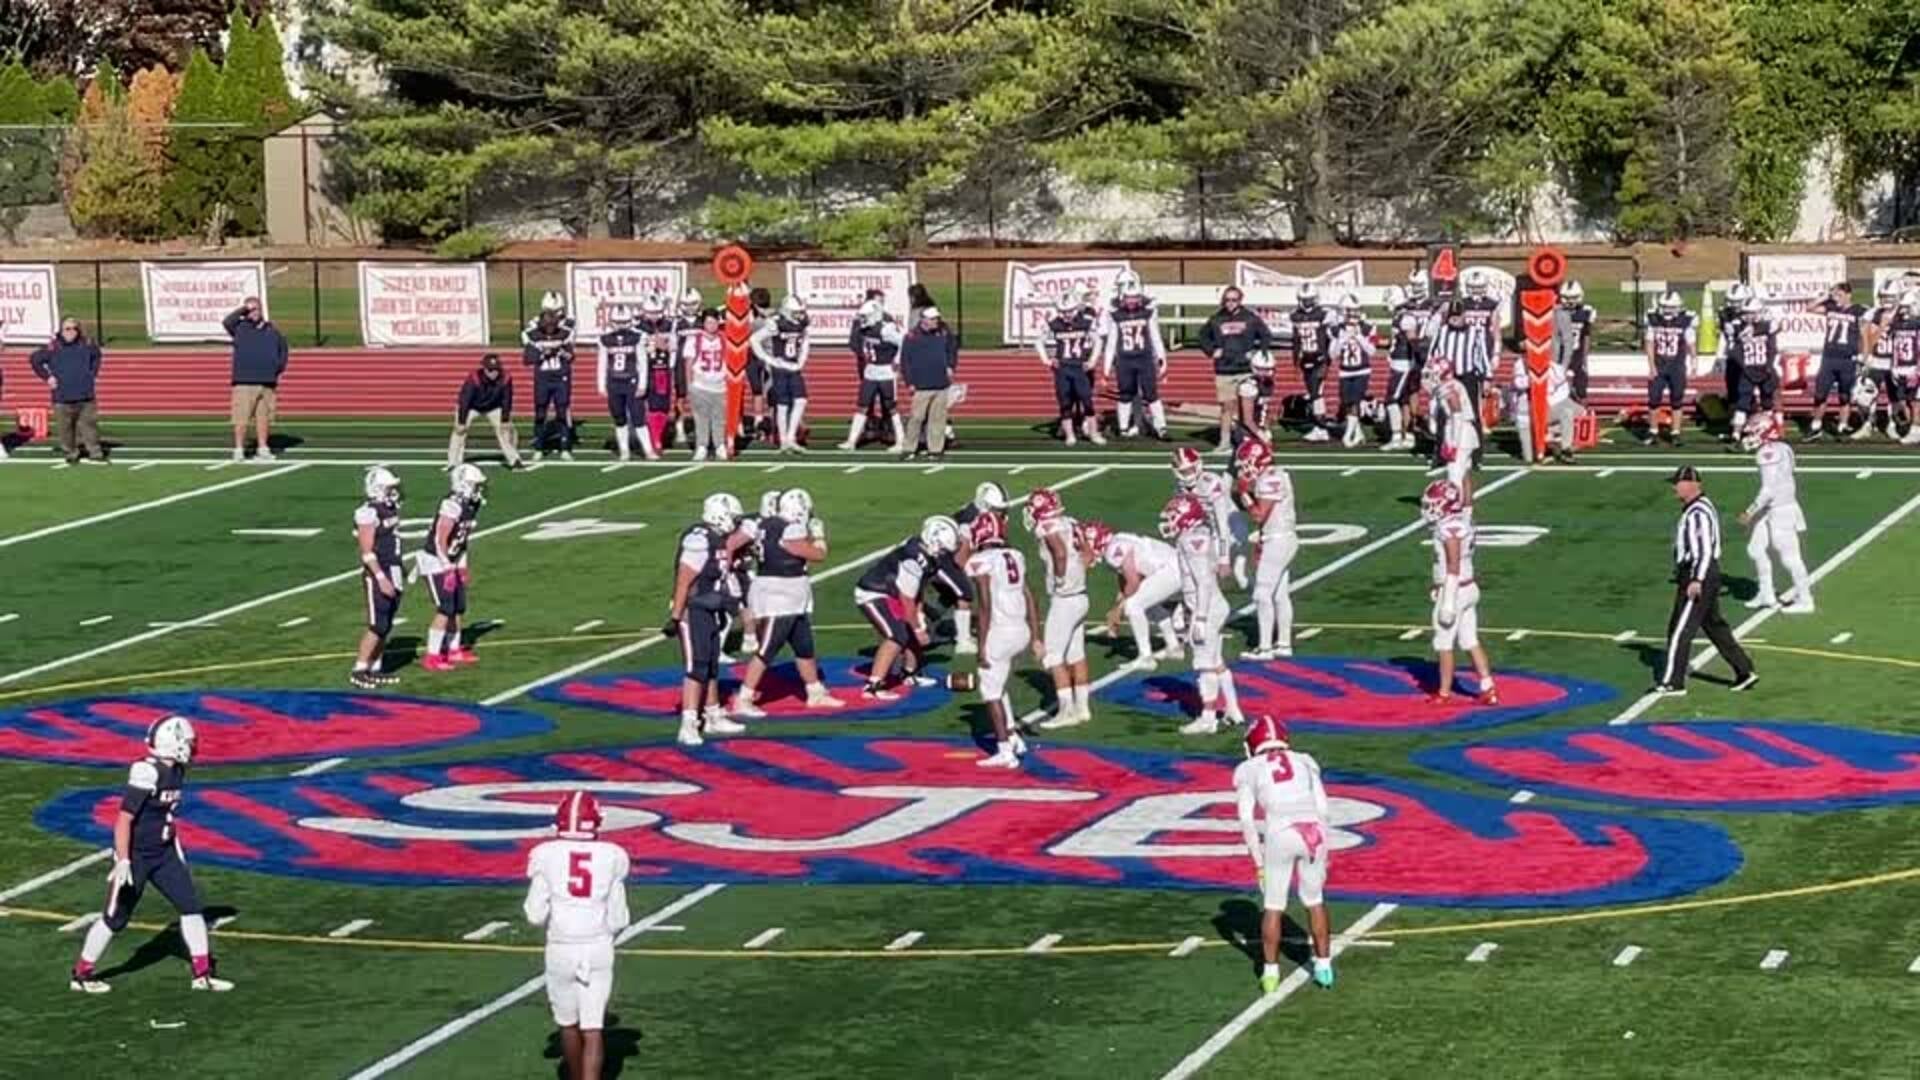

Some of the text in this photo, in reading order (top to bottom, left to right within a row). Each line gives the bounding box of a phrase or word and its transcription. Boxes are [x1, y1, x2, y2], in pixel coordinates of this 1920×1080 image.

[1431, 248, 1458, 281] 4
[811, 275, 893, 290] STRUCTURE
[613, 353, 625, 371] 8
[1266, 751, 1295, 785] 3
[299, 782, 1387, 857] SJB
[567, 851, 592, 898] 5
